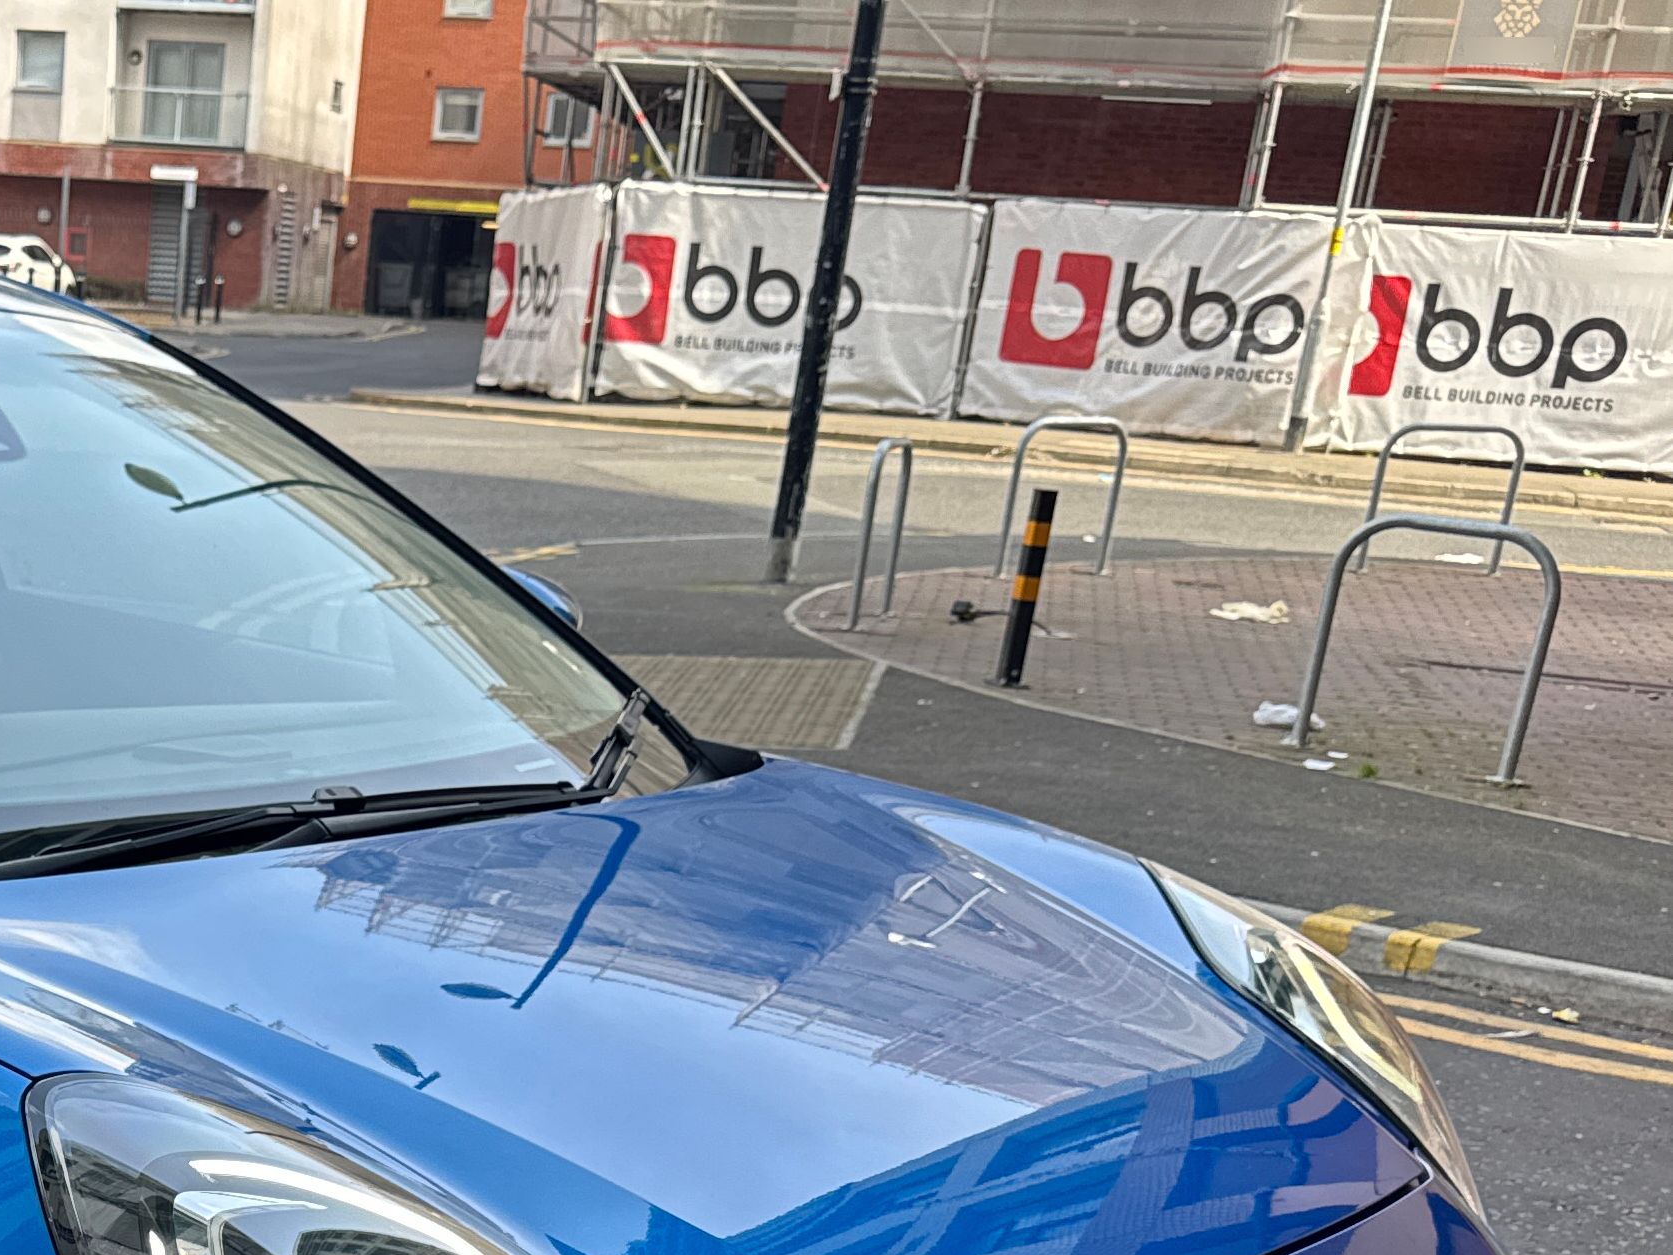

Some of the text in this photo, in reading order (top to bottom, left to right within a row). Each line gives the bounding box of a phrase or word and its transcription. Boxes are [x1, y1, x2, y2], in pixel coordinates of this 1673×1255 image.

[1117, 262, 1305, 363] bbp
[674, 335, 709, 350] BELL
[714, 338, 781, 354] BUILDING
[1416, 283, 1628, 389] bbp
[1104, 359, 1294, 385] BELL BUILDING PROJECTS
[1402, 385, 1614, 413] BELL BUILDING PROJECTS
